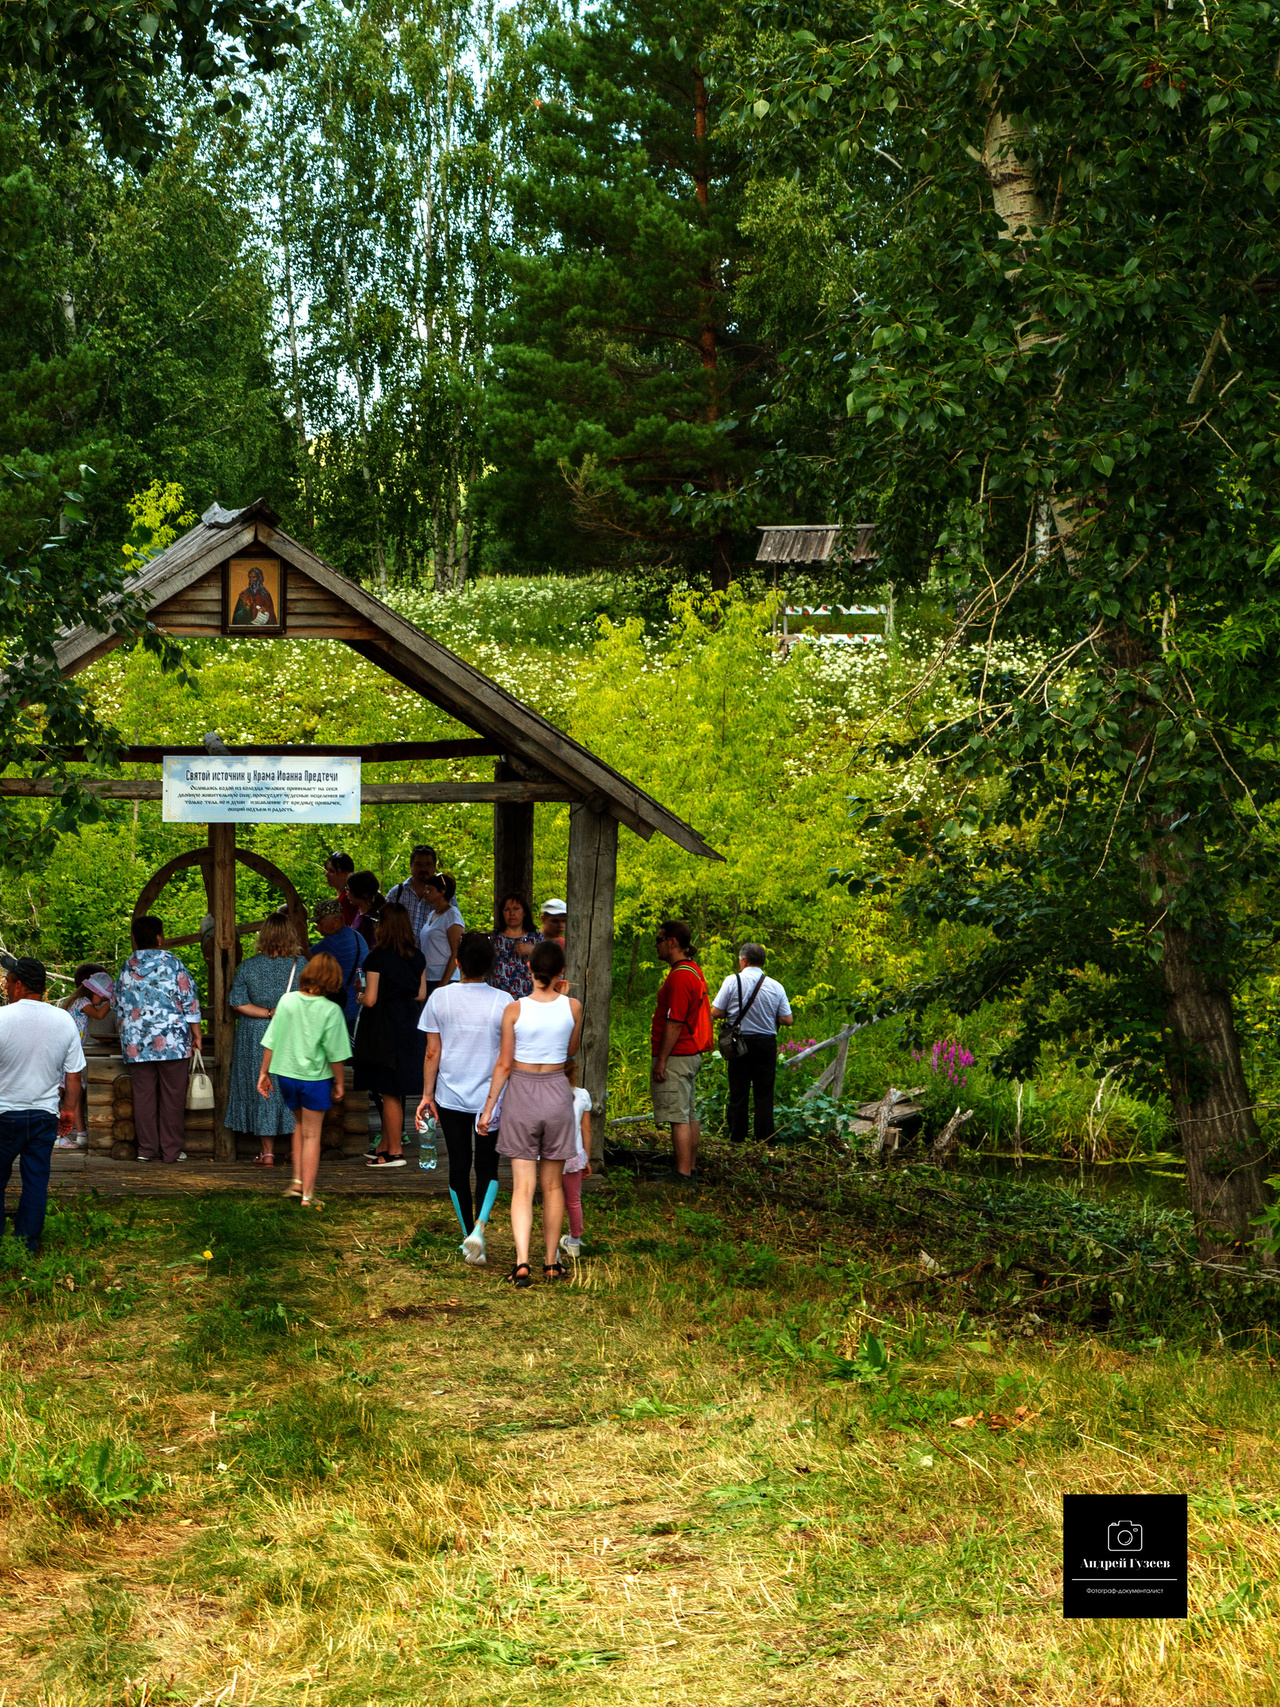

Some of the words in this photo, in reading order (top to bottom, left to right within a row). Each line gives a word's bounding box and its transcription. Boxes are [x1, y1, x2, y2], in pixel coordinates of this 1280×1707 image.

[185, 769, 210, 781] Святой
[212, 771, 245, 781] источник
[253, 770, 275, 783] Храма
[277, 769, 303, 781] Иоанна
[304, 770, 338, 783] Предтечи
